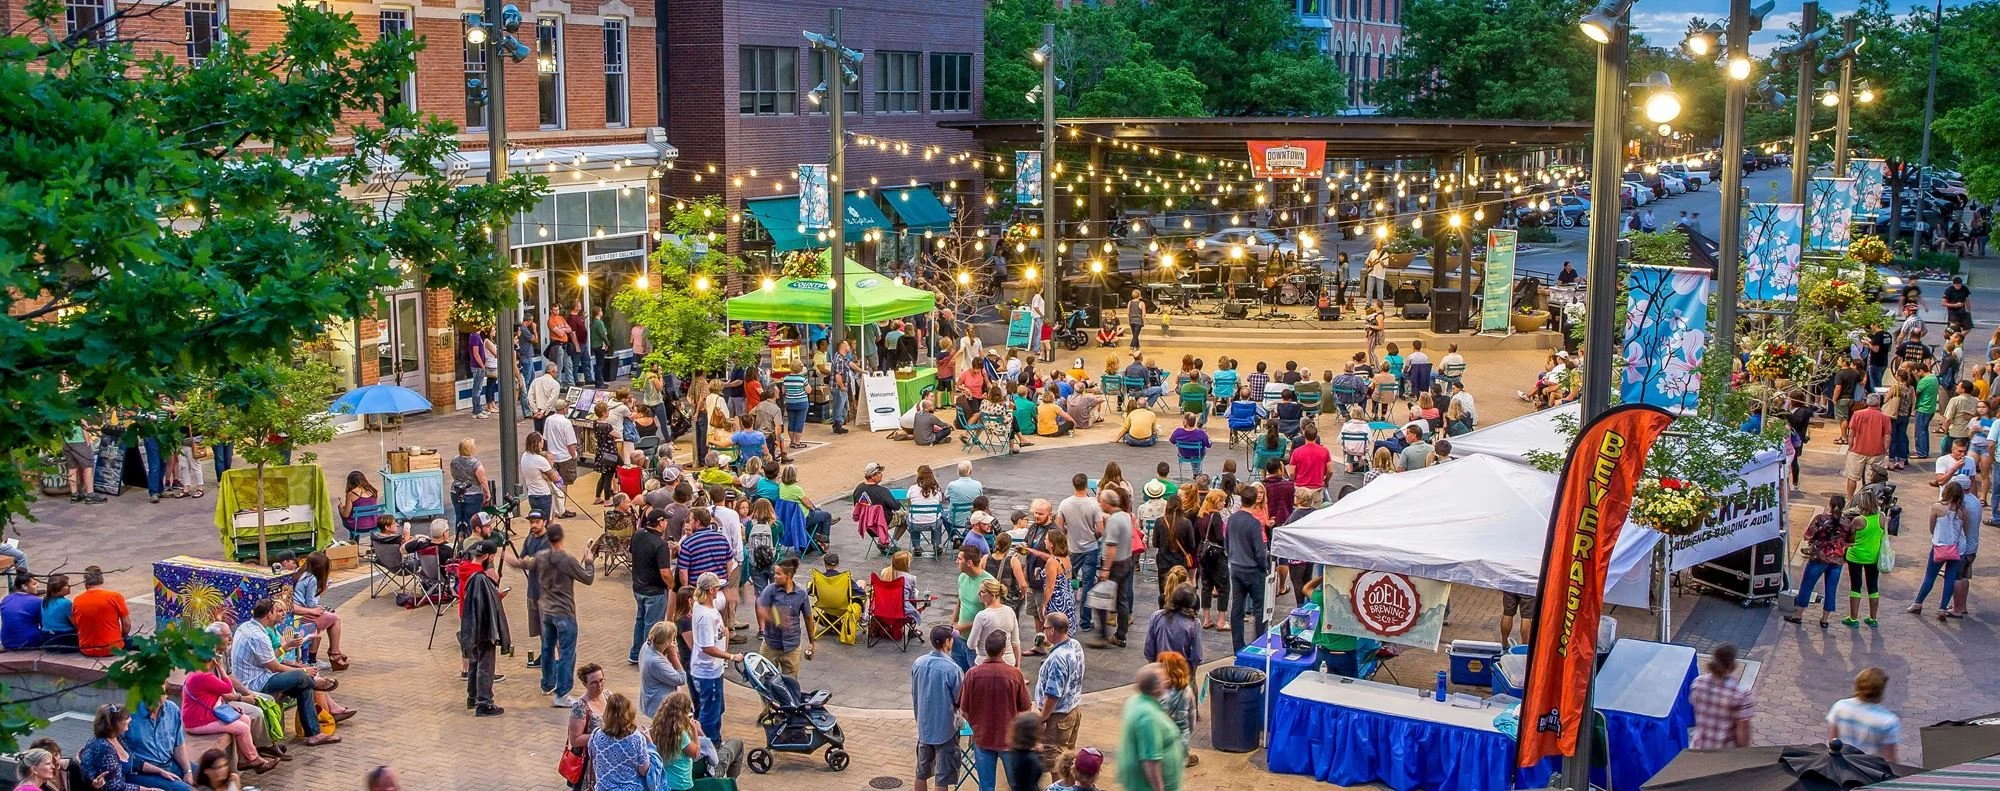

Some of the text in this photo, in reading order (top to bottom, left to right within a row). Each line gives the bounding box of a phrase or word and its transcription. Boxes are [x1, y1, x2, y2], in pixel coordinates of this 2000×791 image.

[1267, 151, 1305, 161] DOWNTOWN
[441, 335, 449, 346] 19
[1556, 429, 1626, 659] BEVERAGES
[1368, 583, 1406, 611] ODELL
[1369, 604, 1405, 619] BREWING
